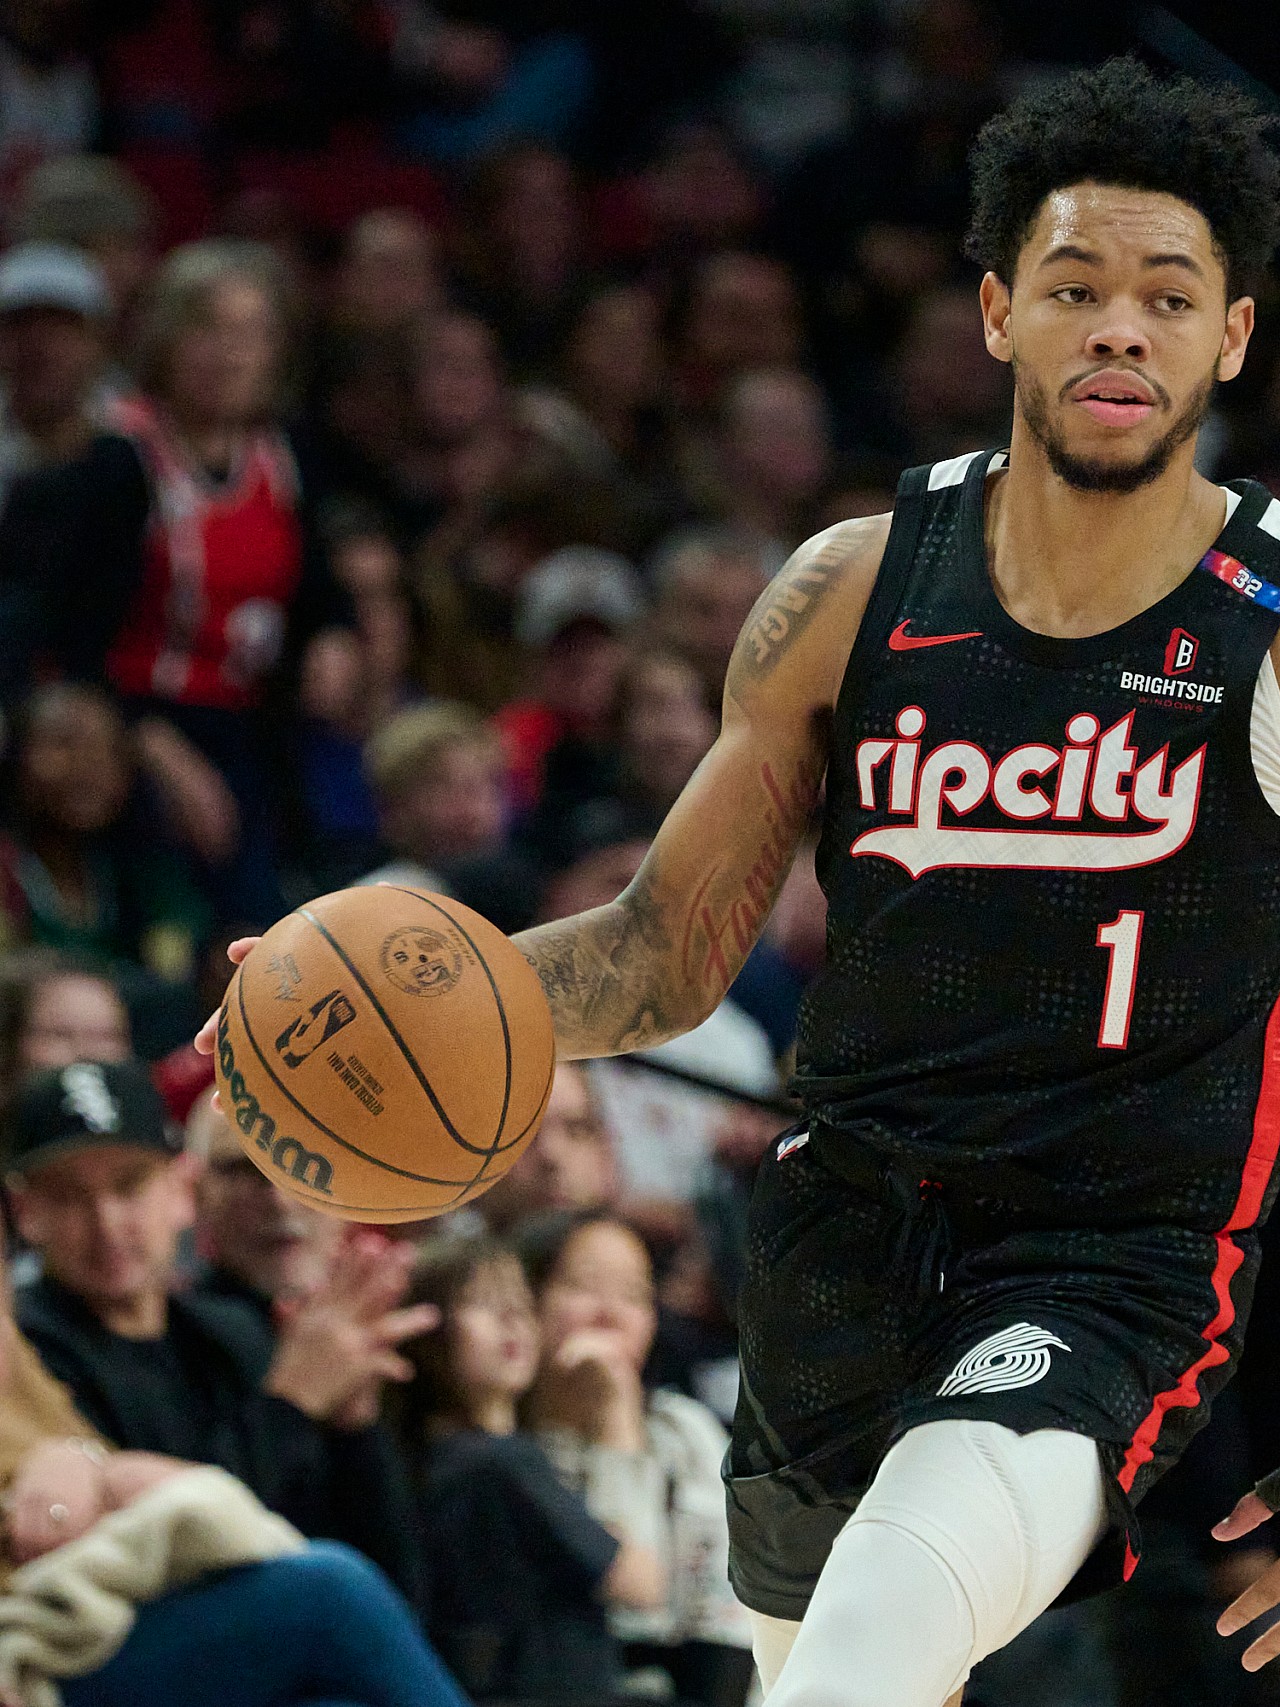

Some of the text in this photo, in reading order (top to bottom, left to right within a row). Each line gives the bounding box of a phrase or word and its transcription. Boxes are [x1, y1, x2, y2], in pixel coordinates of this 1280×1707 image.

[1232, 568, 1263, 599] 32
[1175, 637, 1194, 668] B
[1119, 671, 1225, 704] BRIGHTSIDE
[1138, 695, 1205, 714] WINDOWS
[850, 704, 1208, 881] ripcity
[1095, 908, 1146, 1051] 1
[326, 1049, 346, 1073] BALL
[354, 1083, 386, 1116] OFFICIAL
